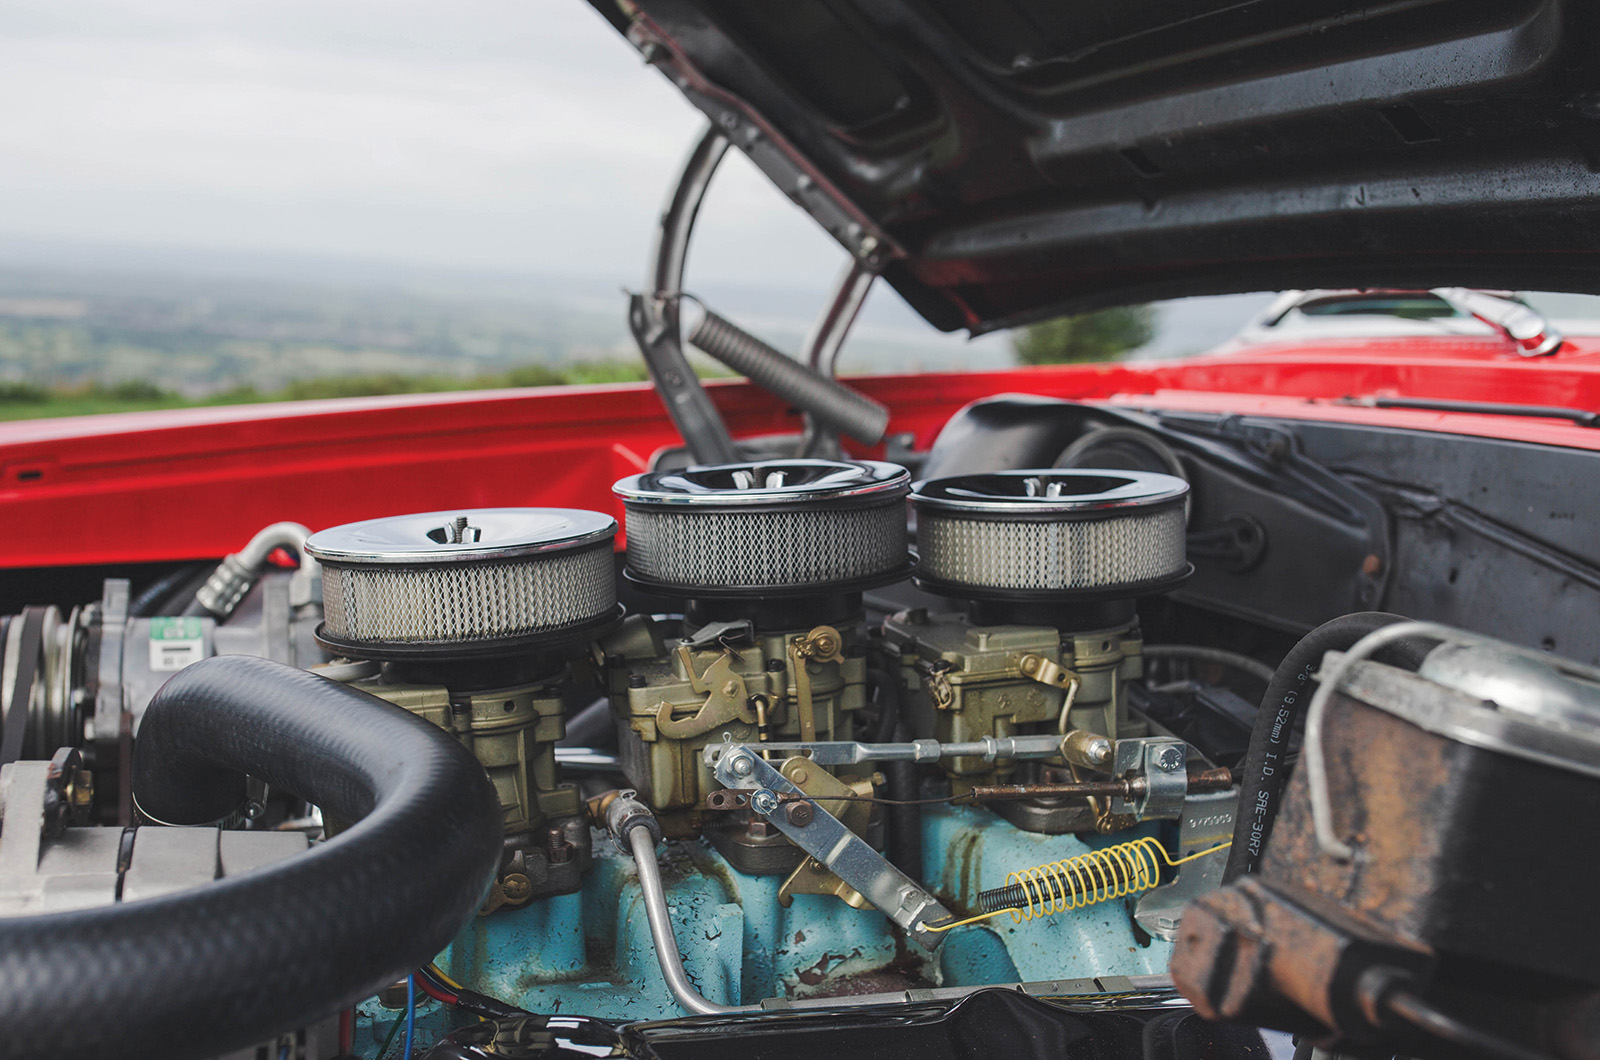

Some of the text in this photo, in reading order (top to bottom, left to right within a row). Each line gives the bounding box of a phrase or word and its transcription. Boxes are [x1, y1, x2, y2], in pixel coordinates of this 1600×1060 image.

[1270, 690, 1298, 744] (9.52mm)
[1261, 752, 1277, 781] I.D.
[1247, 790, 1269, 857] SAE-30R7
